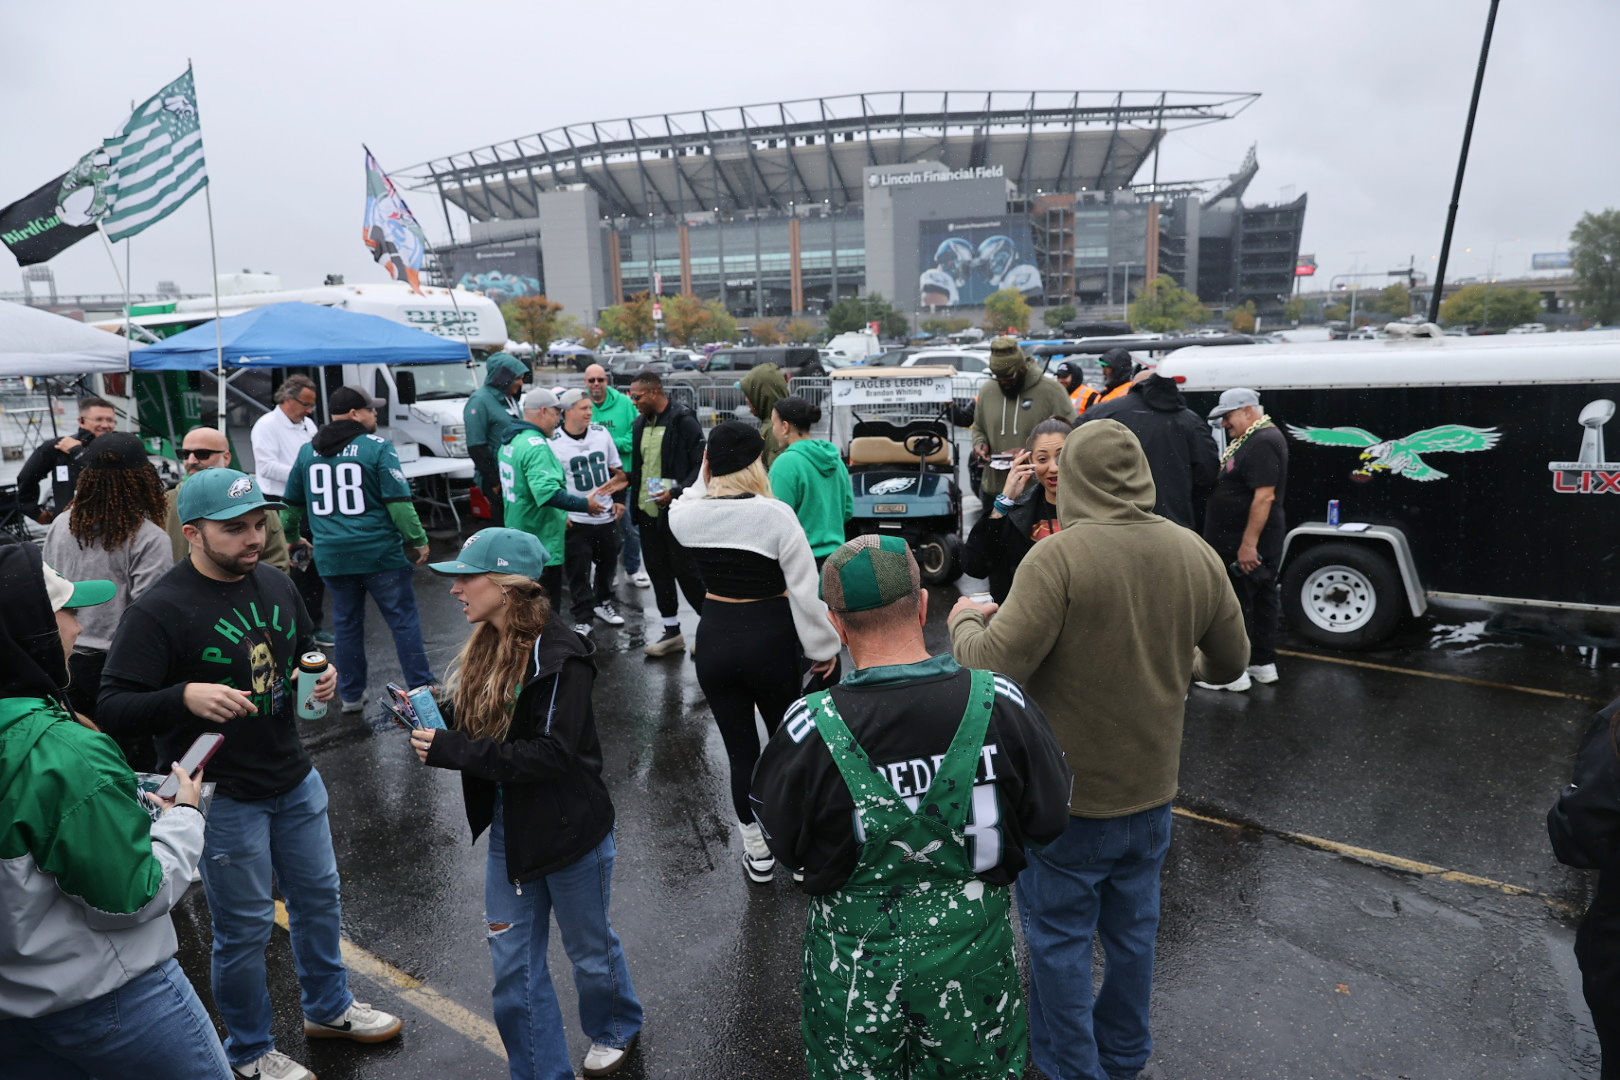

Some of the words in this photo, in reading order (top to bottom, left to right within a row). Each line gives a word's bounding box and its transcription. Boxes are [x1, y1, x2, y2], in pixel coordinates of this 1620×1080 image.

[881, 172, 921, 186] Lincoln
[924, 167, 974, 183] Financial
[976, 165, 1004, 179] Field
[411, 326, 480, 337] ANG
[854, 380, 891, 389] EAGLES
[895, 378, 934, 388] LEGEND
[896, 388, 922, 396] Whiting
[569, 451, 608, 491] 86
[1553, 470, 1620, 494] LIX
[309, 463, 366, 516] 98
[201, 601, 297, 665] PHILLY
